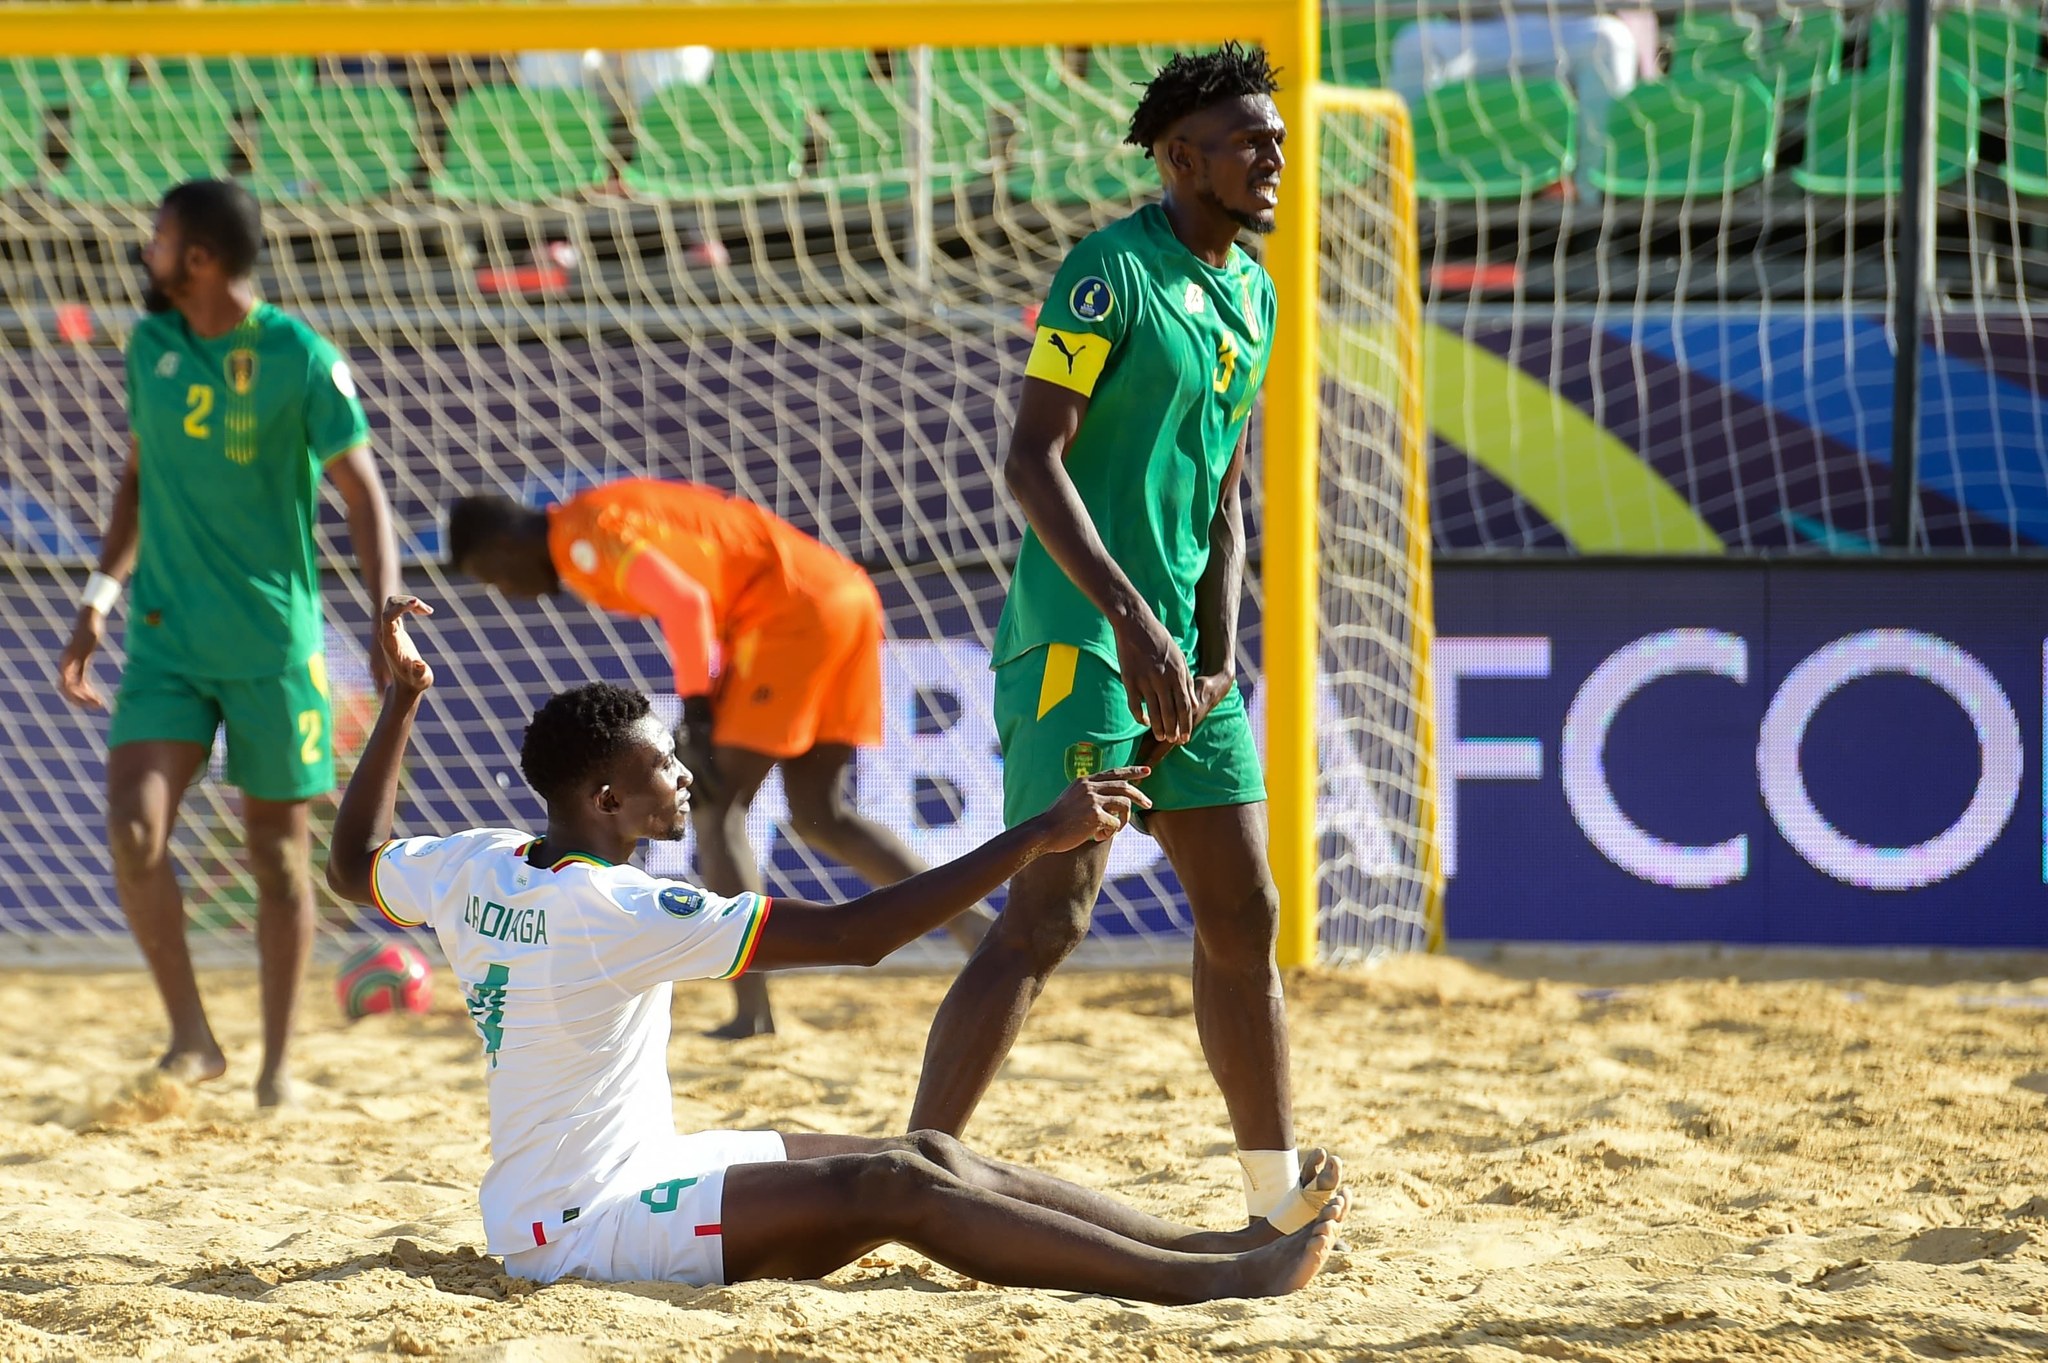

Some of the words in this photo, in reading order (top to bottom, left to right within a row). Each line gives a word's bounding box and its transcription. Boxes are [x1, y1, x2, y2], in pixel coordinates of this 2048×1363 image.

[1213, 329, 1239, 394] 3
[183, 384, 214, 439] 2
[298, 709, 323, 766] 2
